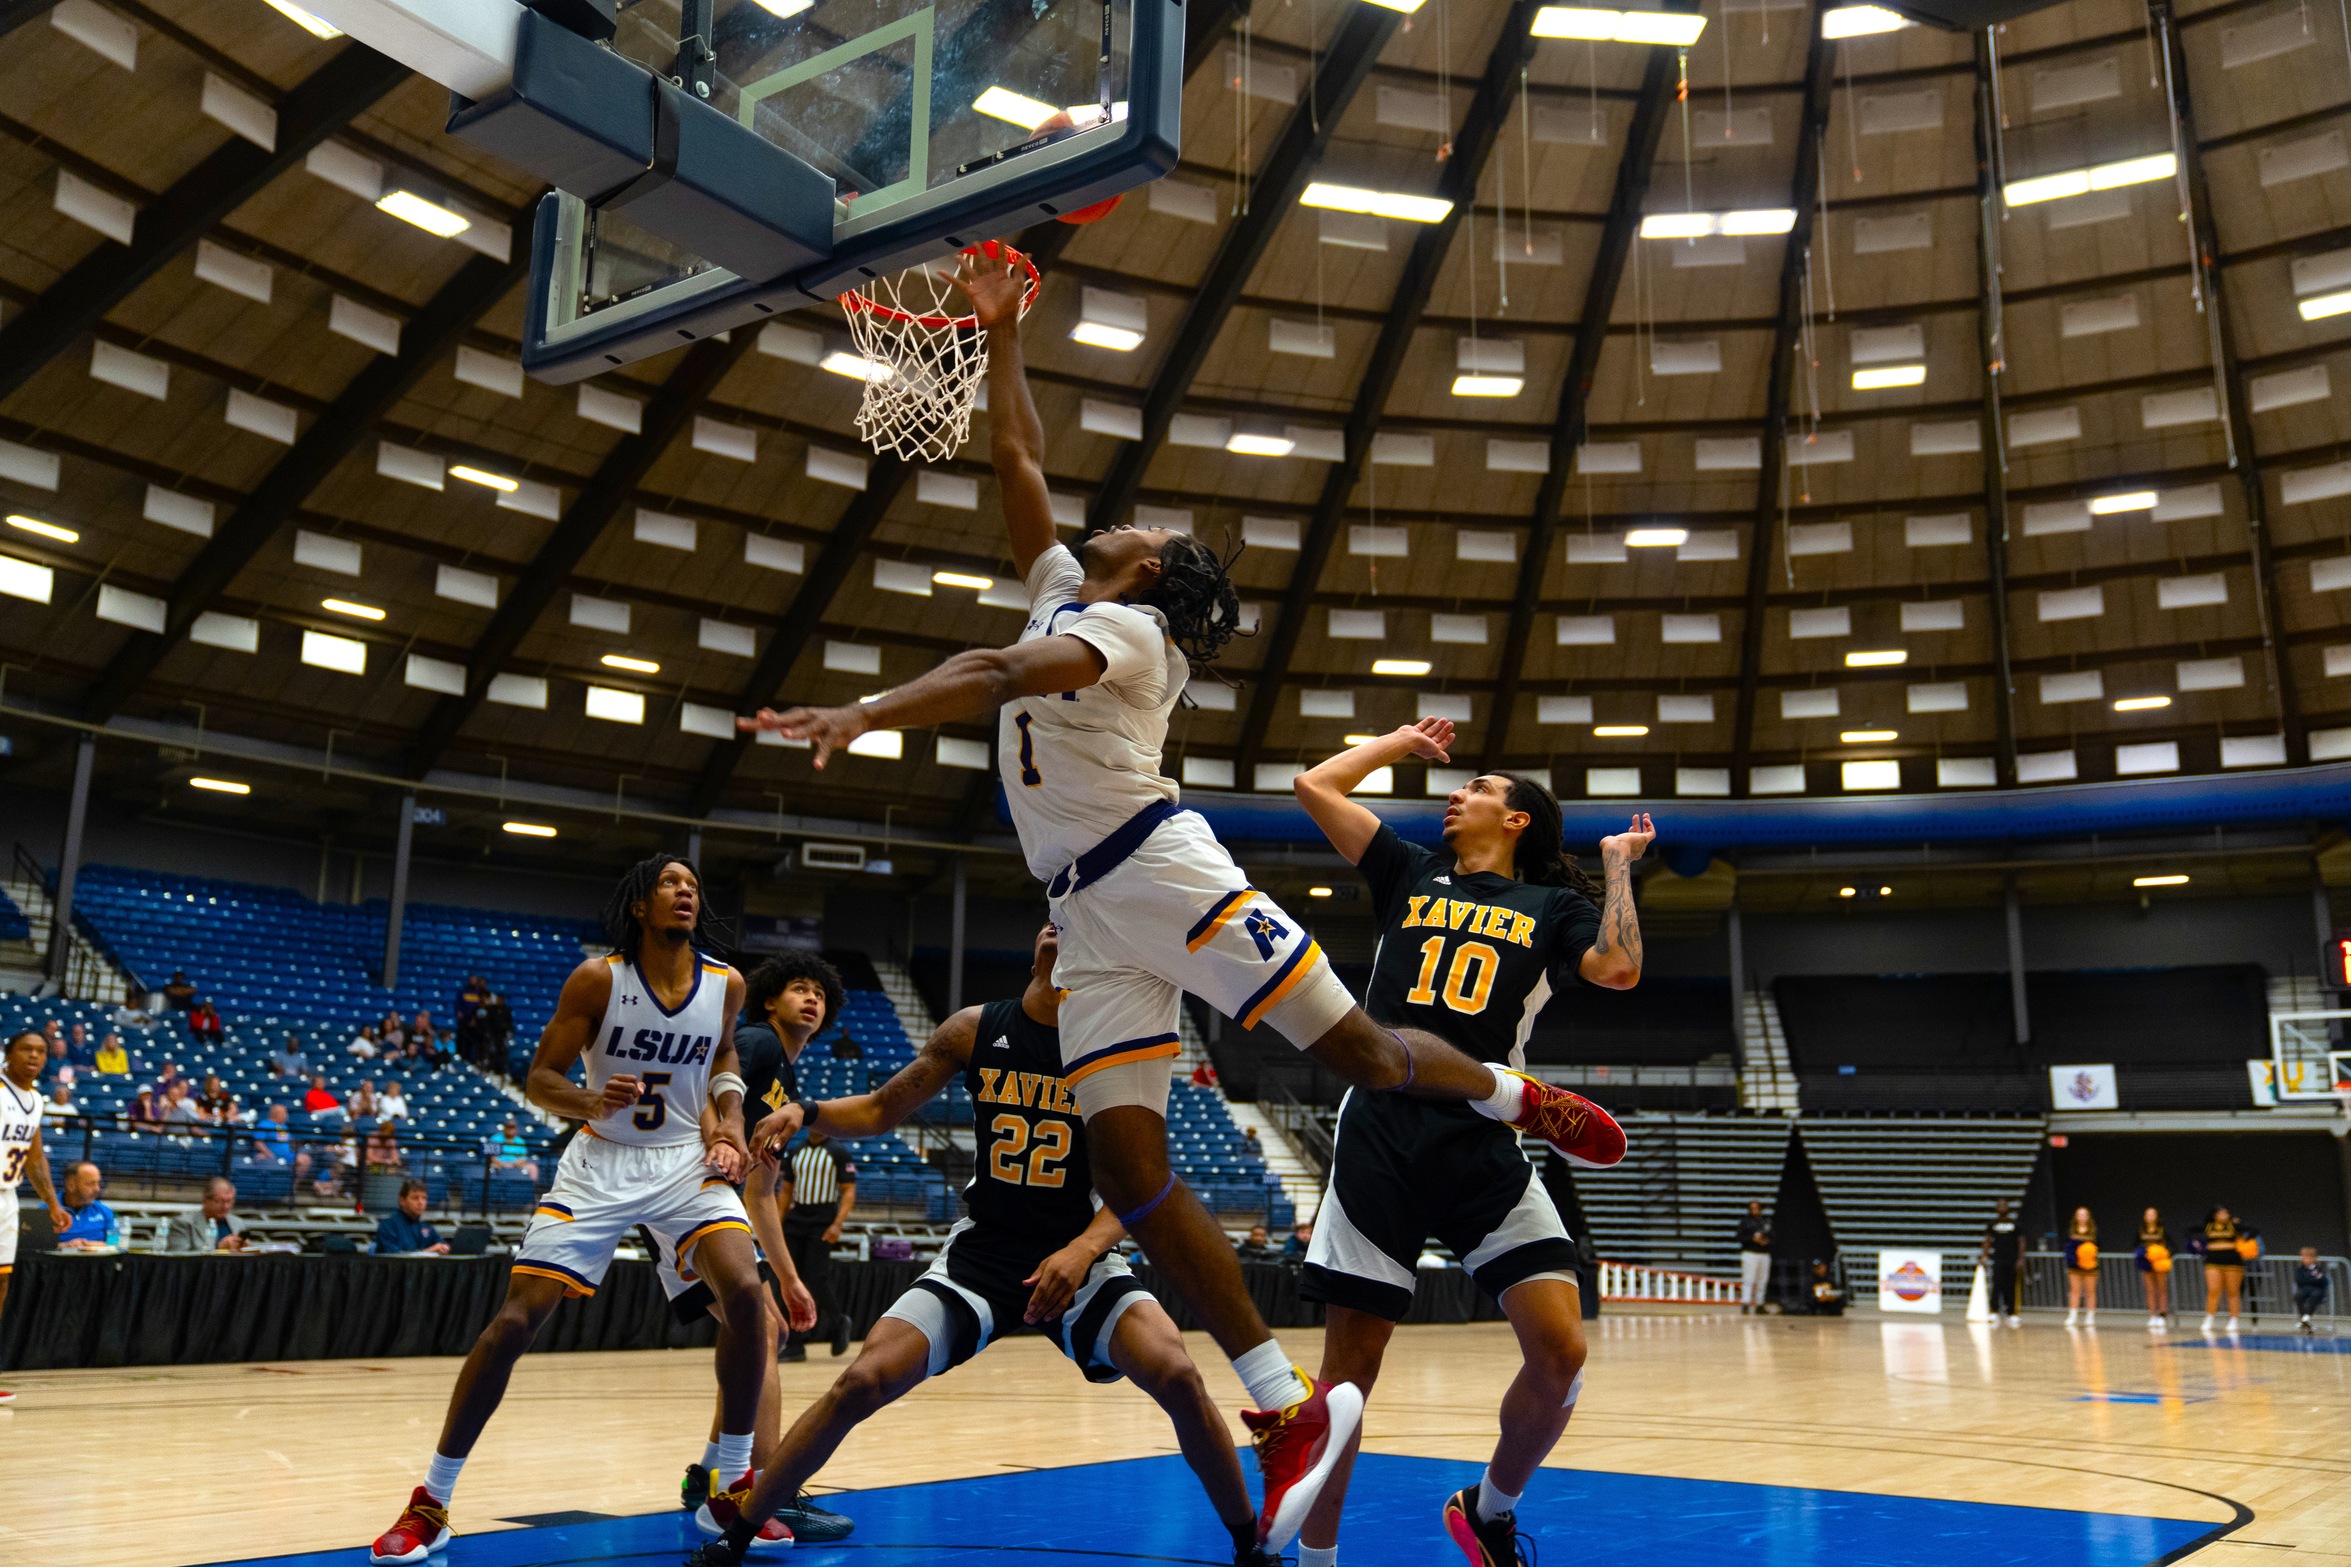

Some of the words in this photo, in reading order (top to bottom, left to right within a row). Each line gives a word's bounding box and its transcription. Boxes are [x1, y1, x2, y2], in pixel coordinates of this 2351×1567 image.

[1014, 707, 1042, 788] 1
[1402, 895, 1536, 948] XAVIER
[1406, 935, 1501, 1016] 10
[605, 1026, 712, 1066] LSUA
[632, 1071, 673, 1132] 5
[990, 1112, 1073, 1188] 22
